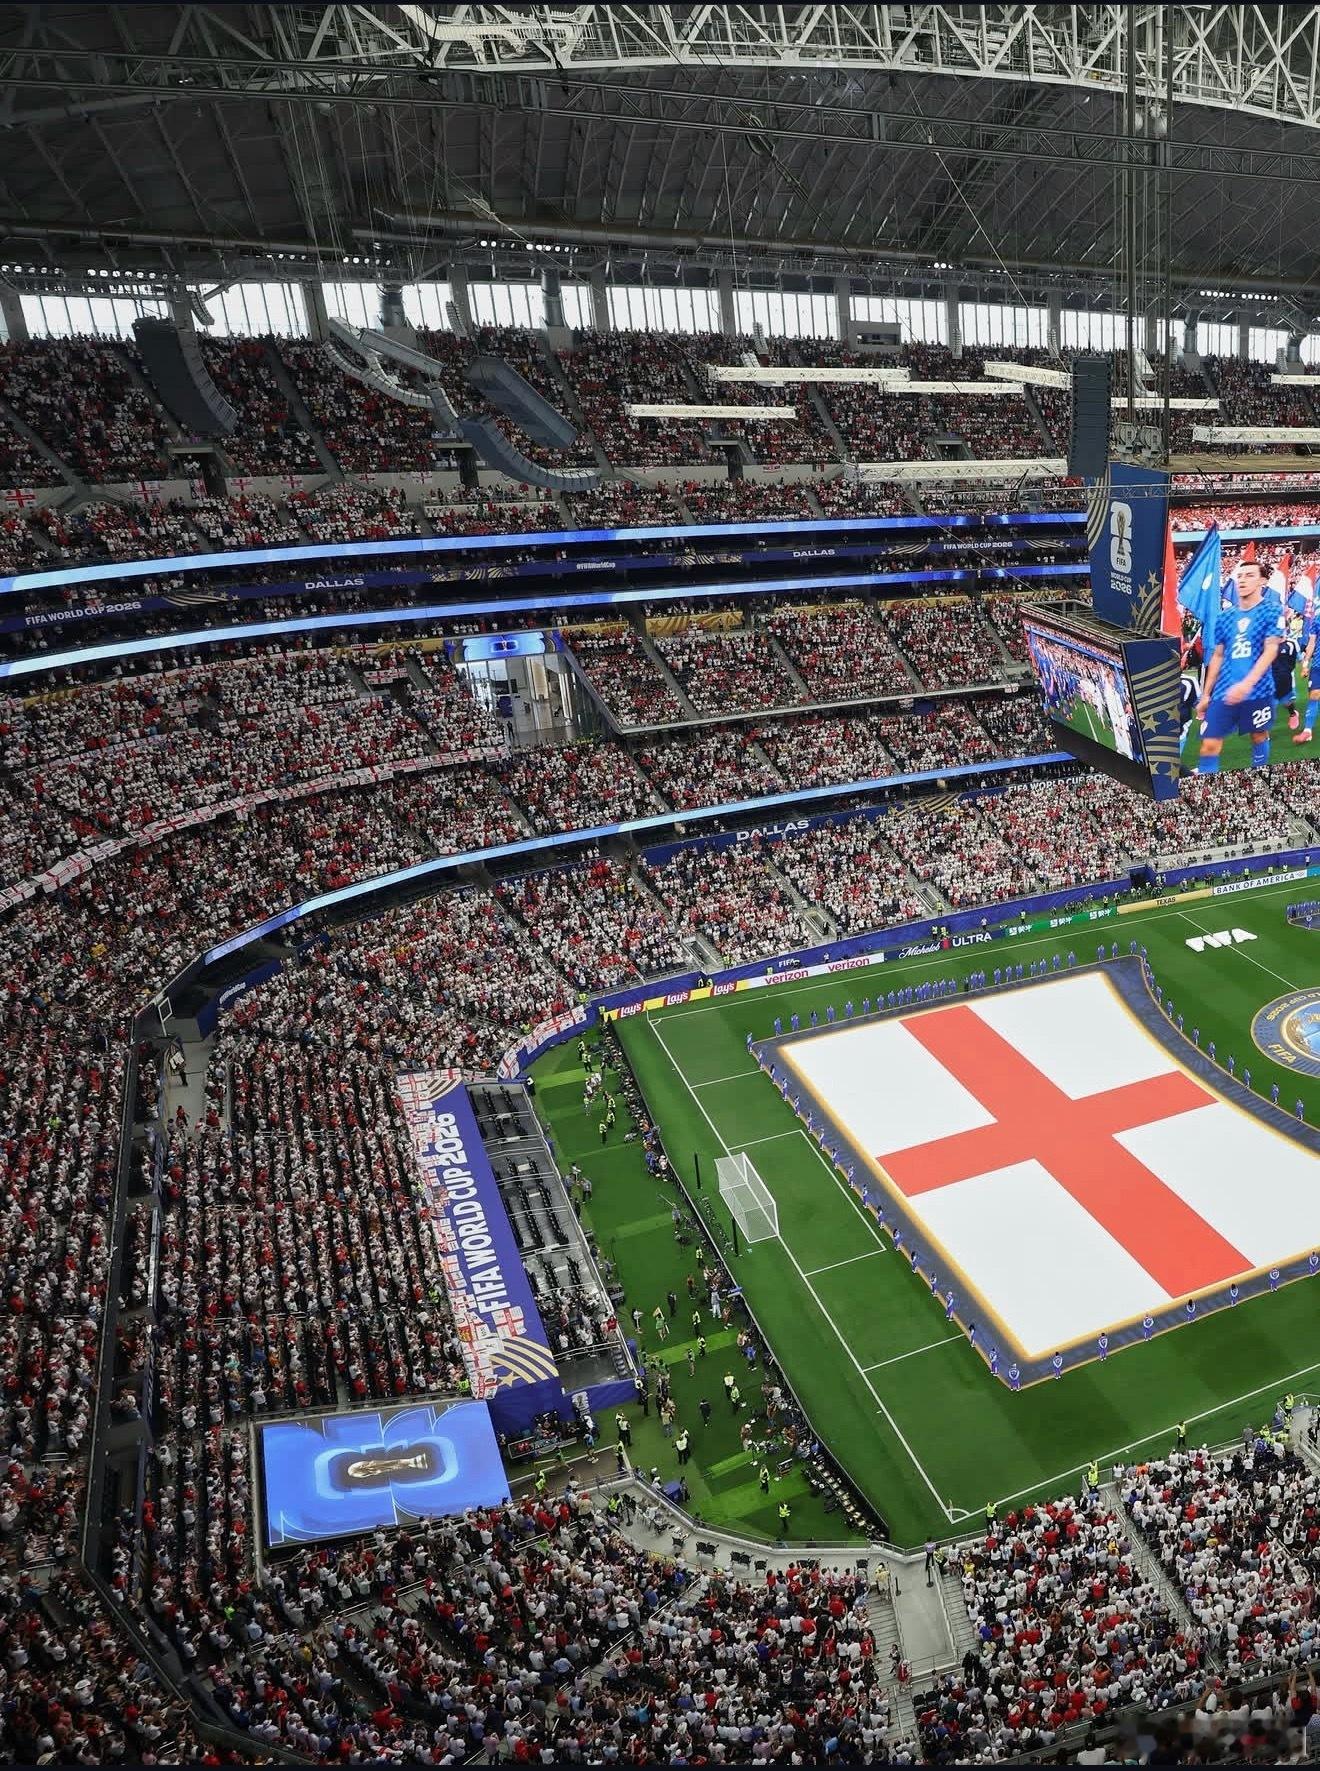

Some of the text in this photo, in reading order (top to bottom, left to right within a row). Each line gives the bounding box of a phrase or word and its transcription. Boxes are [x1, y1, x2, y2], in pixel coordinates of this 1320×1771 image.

[793, 549, 835, 557] DALLAS
[1116, 557, 1127, 567] FIFA
[304, 578, 364, 590] DALLAS
[1110, 579, 1132, 595] 2026
[25, 615, 48, 626] FIFA
[48, 609, 84, 621] WORLD
[105, 601, 142, 613] 2026
[1231, 640, 1252, 660] 26
[1252, 706, 1272, 725] 26
[1008, 784, 1028, 794] FIFA
[1065, 776, 1085, 785] CUP
[736, 820, 809, 841] DALLAS
[1216, 873, 1295, 894] BANK OF AMERICA
[1156, 896, 1176, 905] TEXAS
[899, 932, 992, 959] Michelob ULTRA
[765, 958, 870, 985] verizon verizon
[620, 982, 735, 1018] Lay's Lay's Lay's
[1268, 1044, 1296, 1063] FIFA
[434, 1113, 511, 1314] FIFA WORLD CUP 2026
